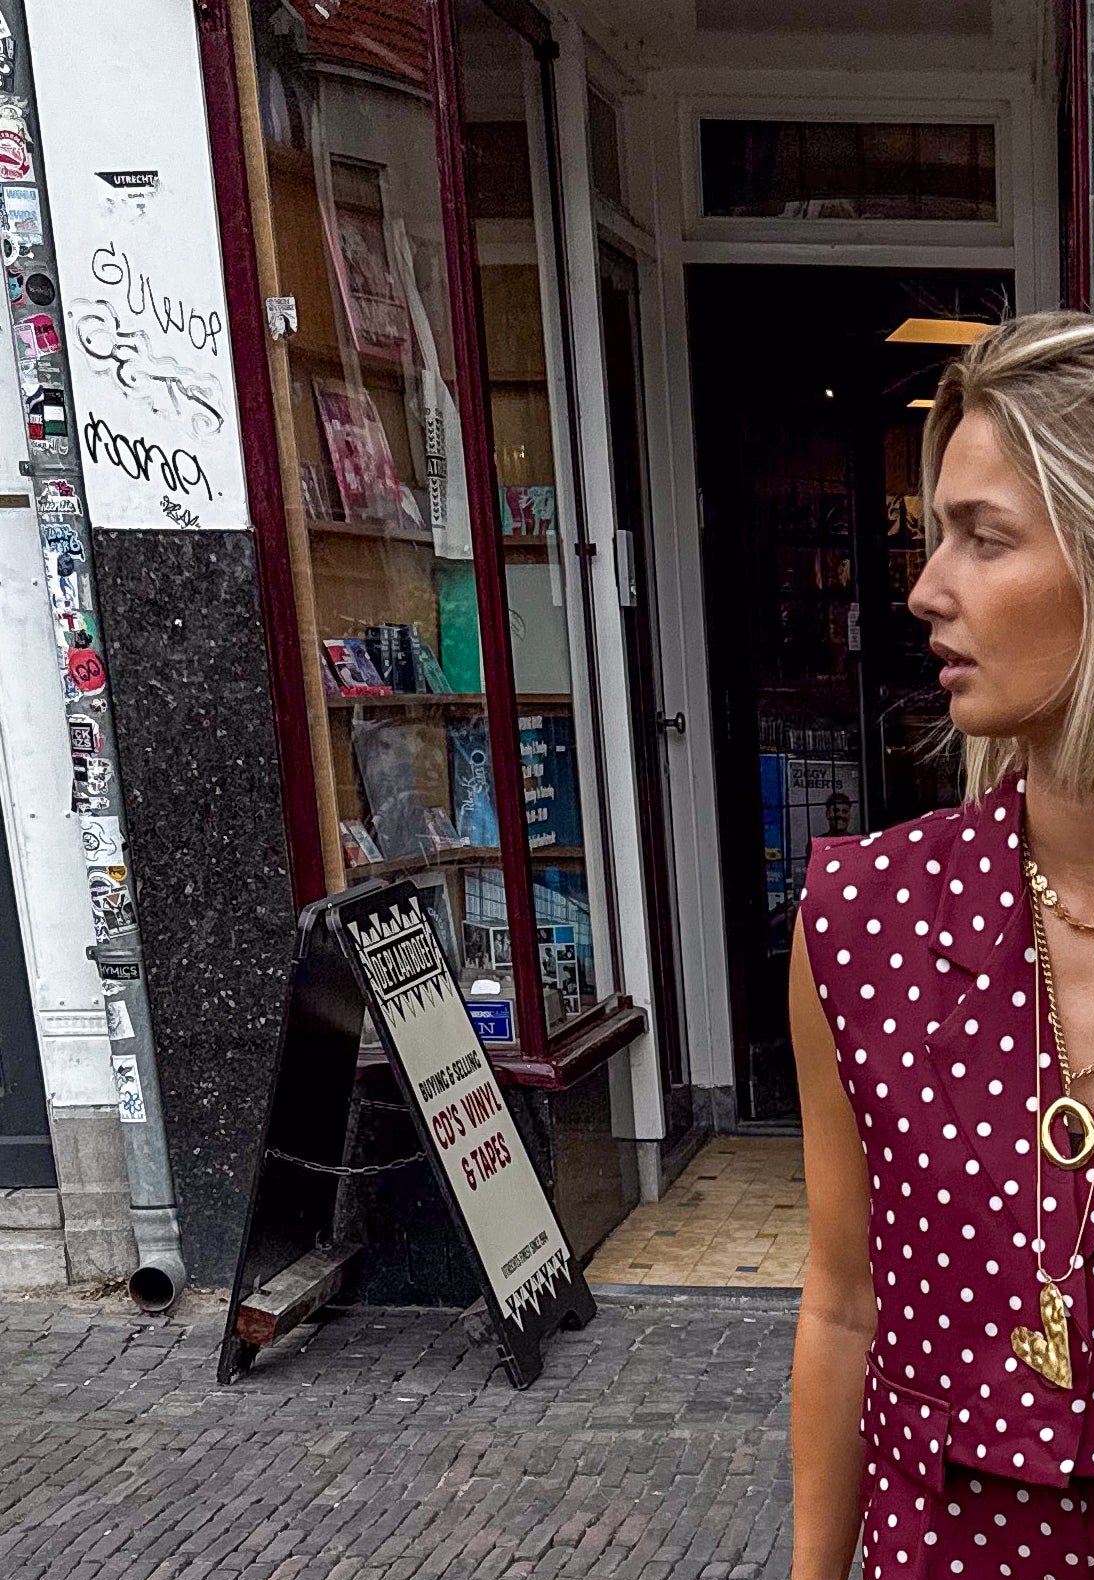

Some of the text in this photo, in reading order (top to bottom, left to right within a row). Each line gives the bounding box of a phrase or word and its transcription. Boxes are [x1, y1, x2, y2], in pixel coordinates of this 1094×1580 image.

[113, 174, 154, 185] UTRECHT
[418, 1050, 482, 1103] BUYING & SELLING
[432, 1081, 502, 1150] CD'S VINYL
[461, 1132, 512, 1191] & TAPES
